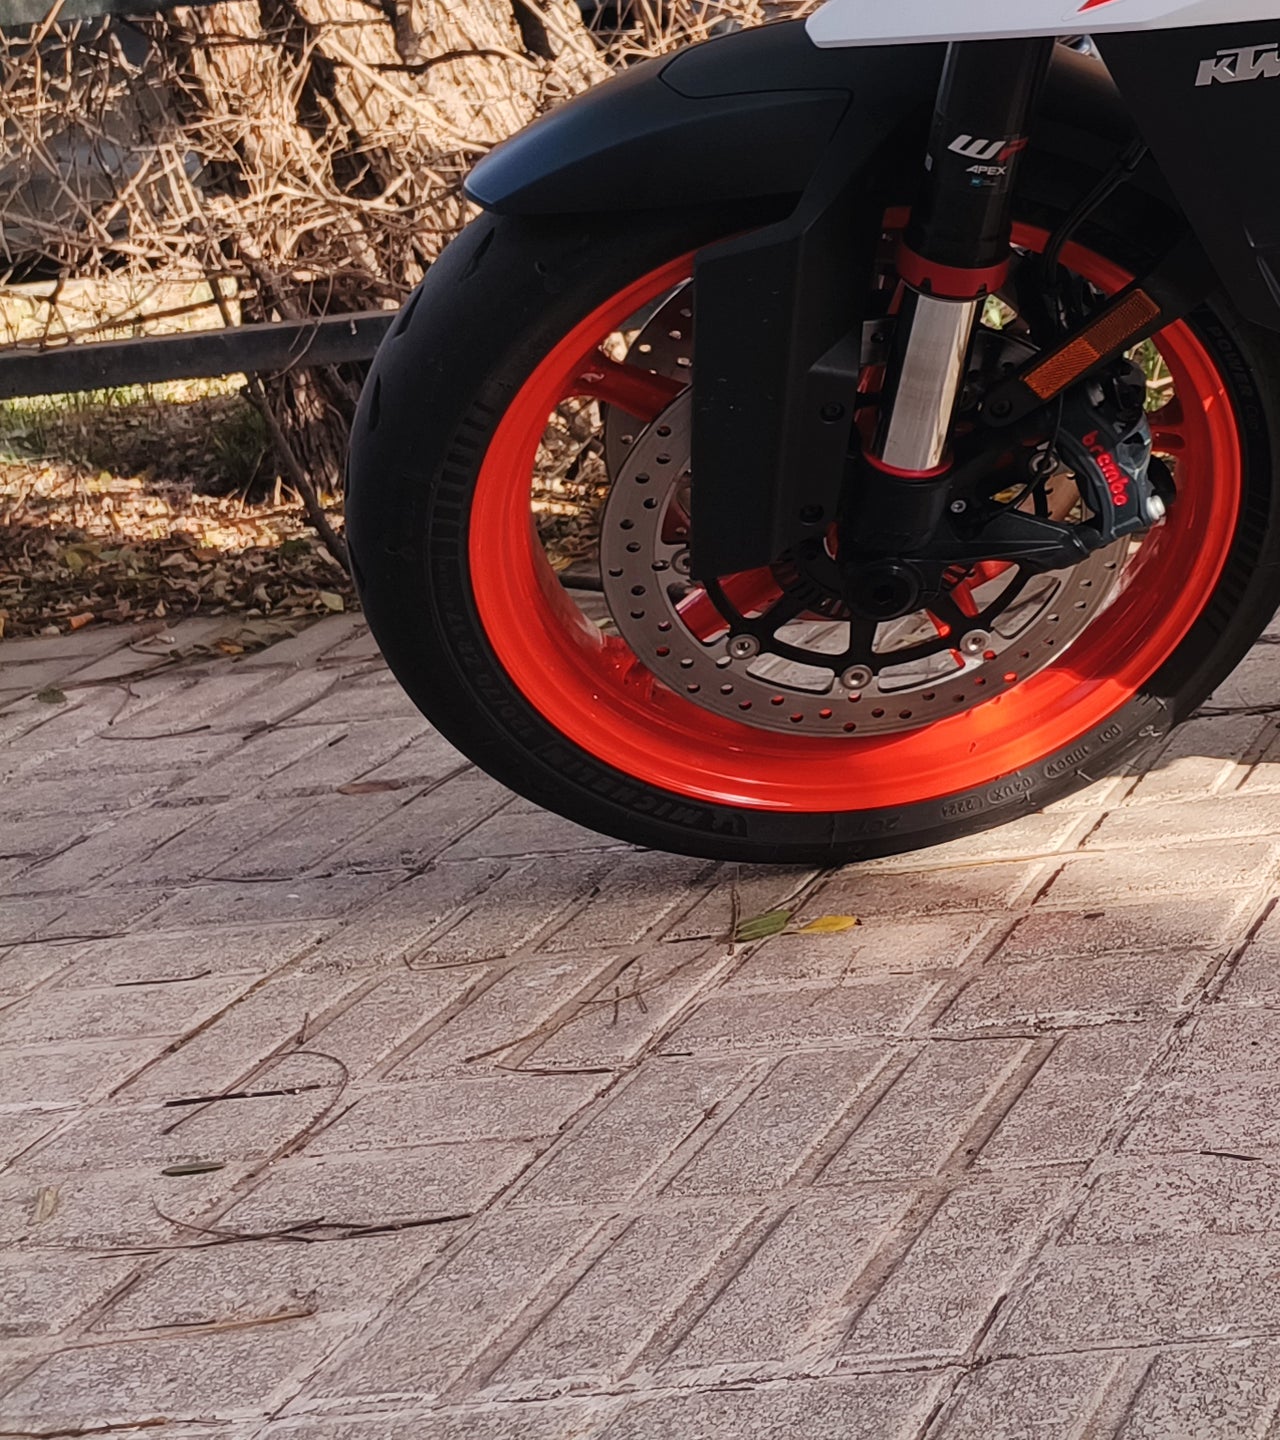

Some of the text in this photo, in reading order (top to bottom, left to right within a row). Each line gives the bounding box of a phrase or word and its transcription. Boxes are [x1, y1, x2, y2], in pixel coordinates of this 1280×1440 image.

[966, 165, 1007, 176] APEX
[1082, 430, 1129, 507] brembo
[541, 743, 705, 826] MICHELIN
